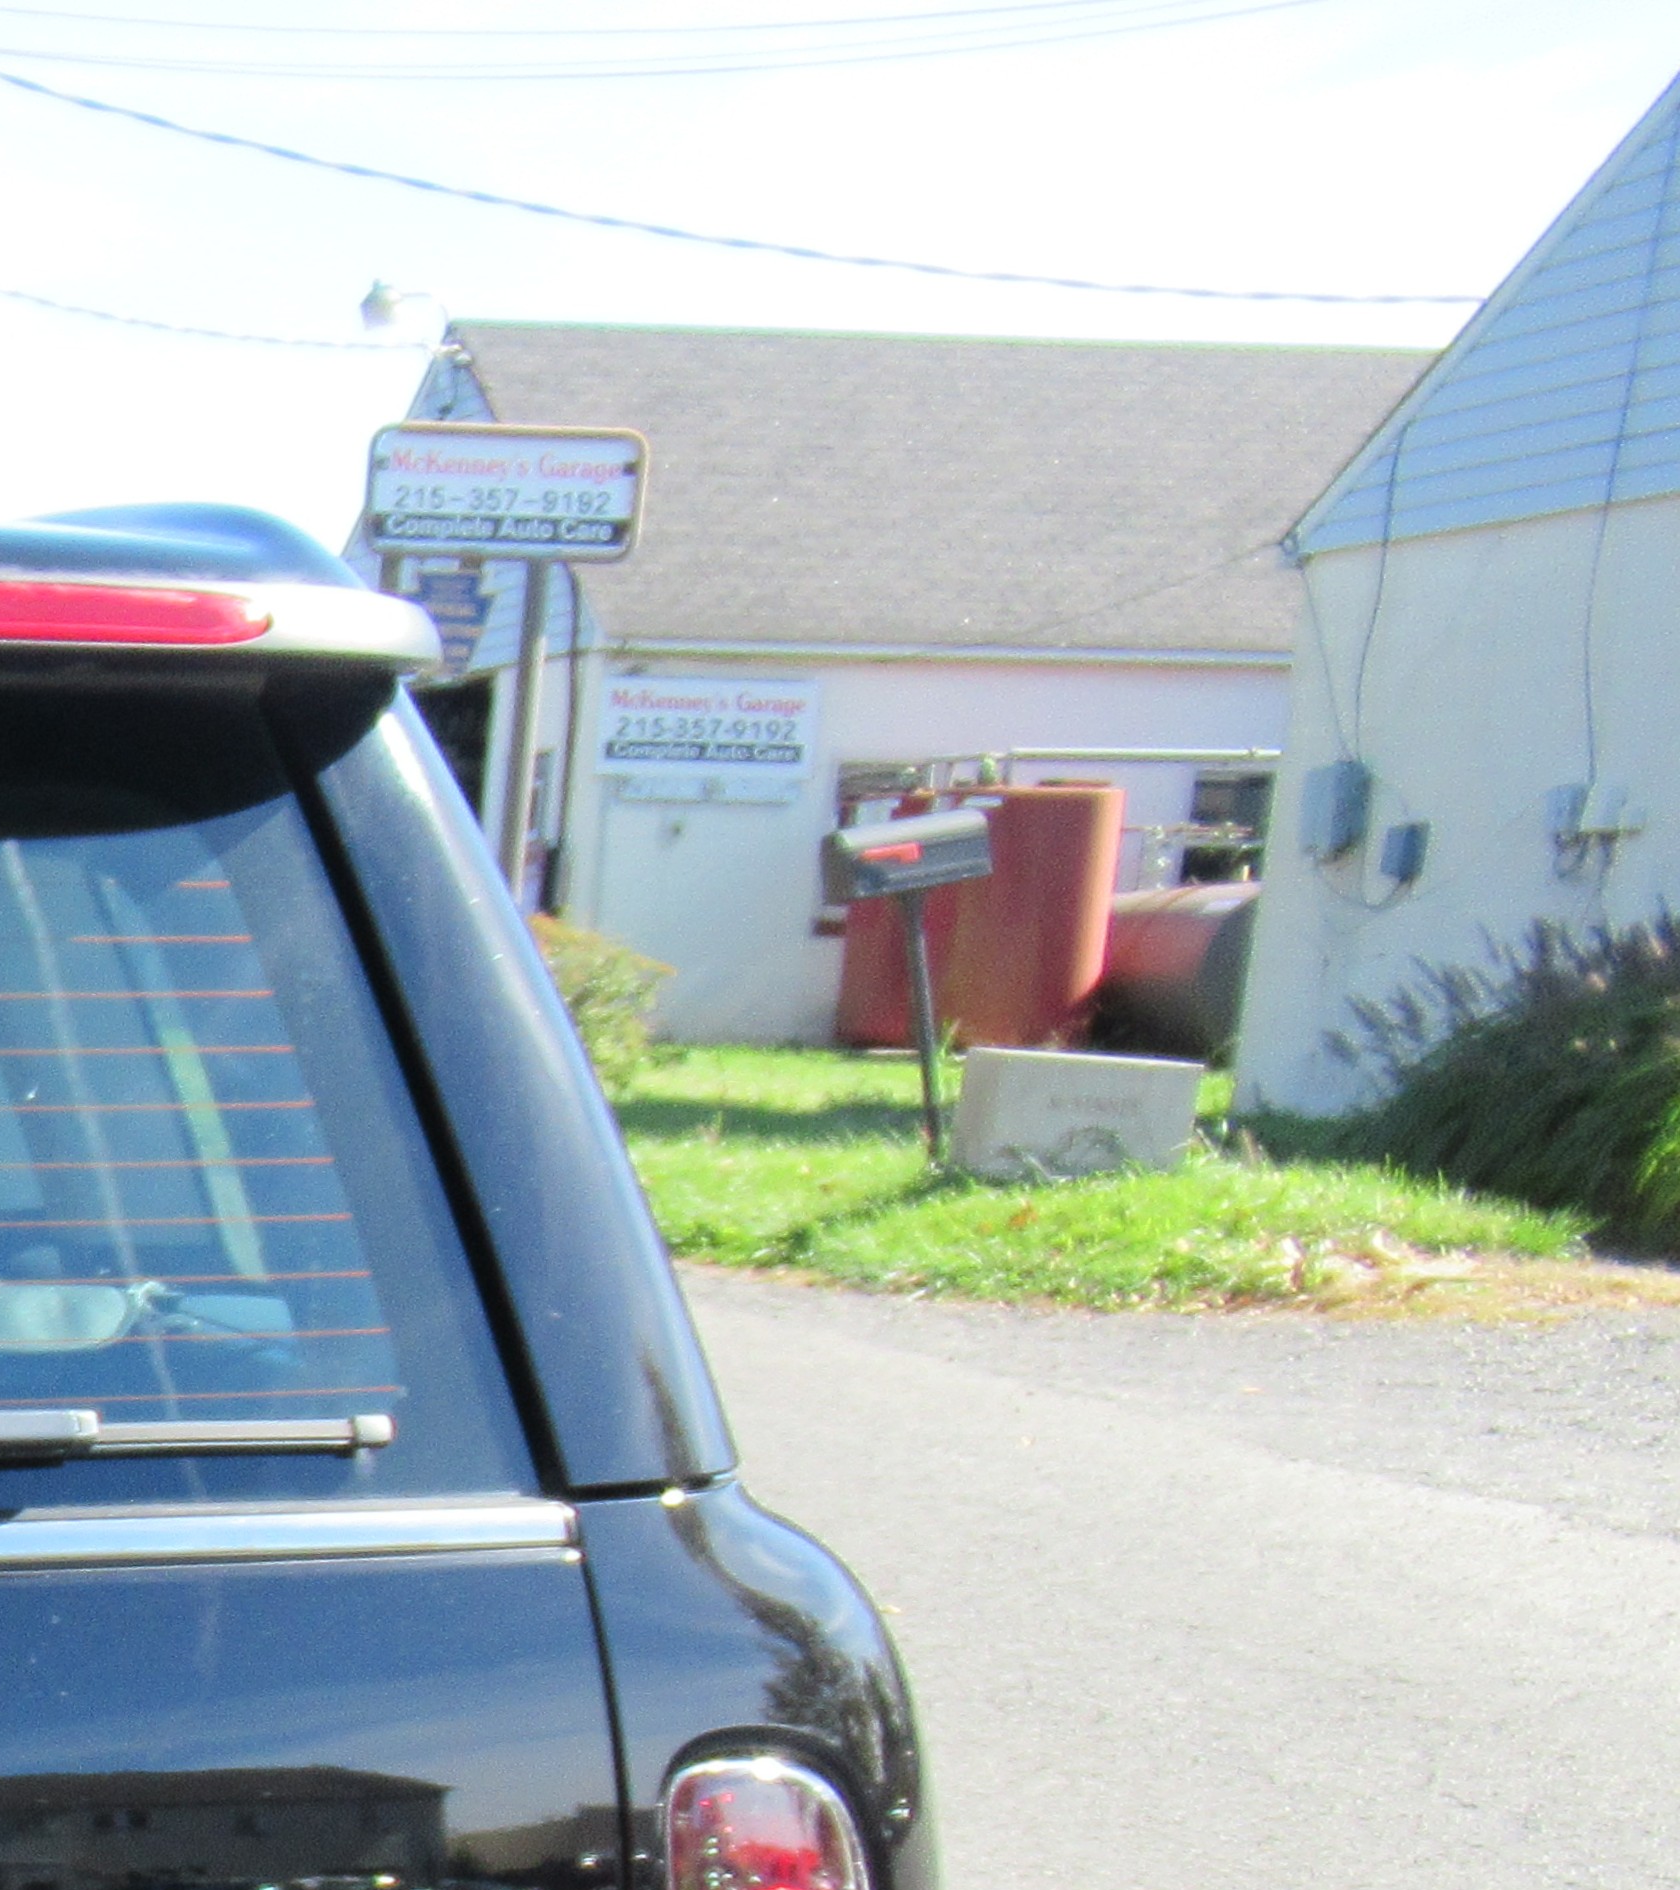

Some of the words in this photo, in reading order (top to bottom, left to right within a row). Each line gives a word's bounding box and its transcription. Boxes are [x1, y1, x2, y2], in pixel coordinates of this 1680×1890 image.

[539, 452, 623, 483] Garage
[395, 486, 611, 513] 215-357-9192
[389, 515, 493, 538] Complete
[498, 519, 553, 540] Auto
[558, 520, 613, 542] Care
[616, 716, 797, 740] 215-357-9192
